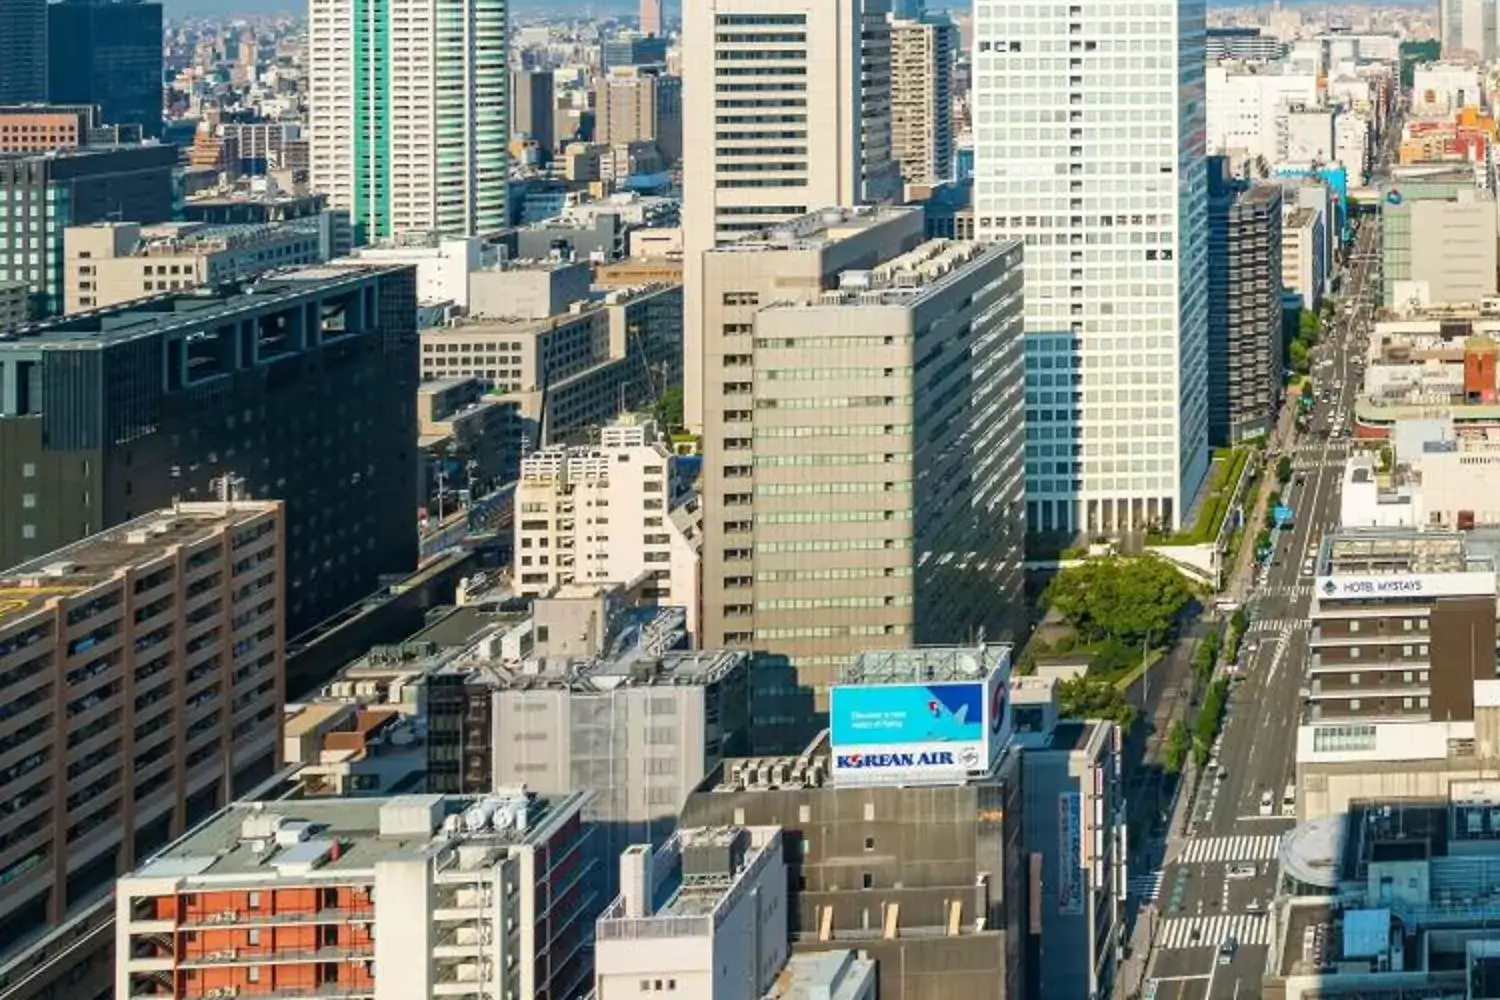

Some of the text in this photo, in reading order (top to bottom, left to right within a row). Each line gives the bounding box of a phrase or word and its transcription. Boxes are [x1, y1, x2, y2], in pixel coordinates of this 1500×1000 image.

[1343, 579, 1423, 593] HOTEL MYSTAYS
[837, 751, 954, 769] KOREAN AIR
